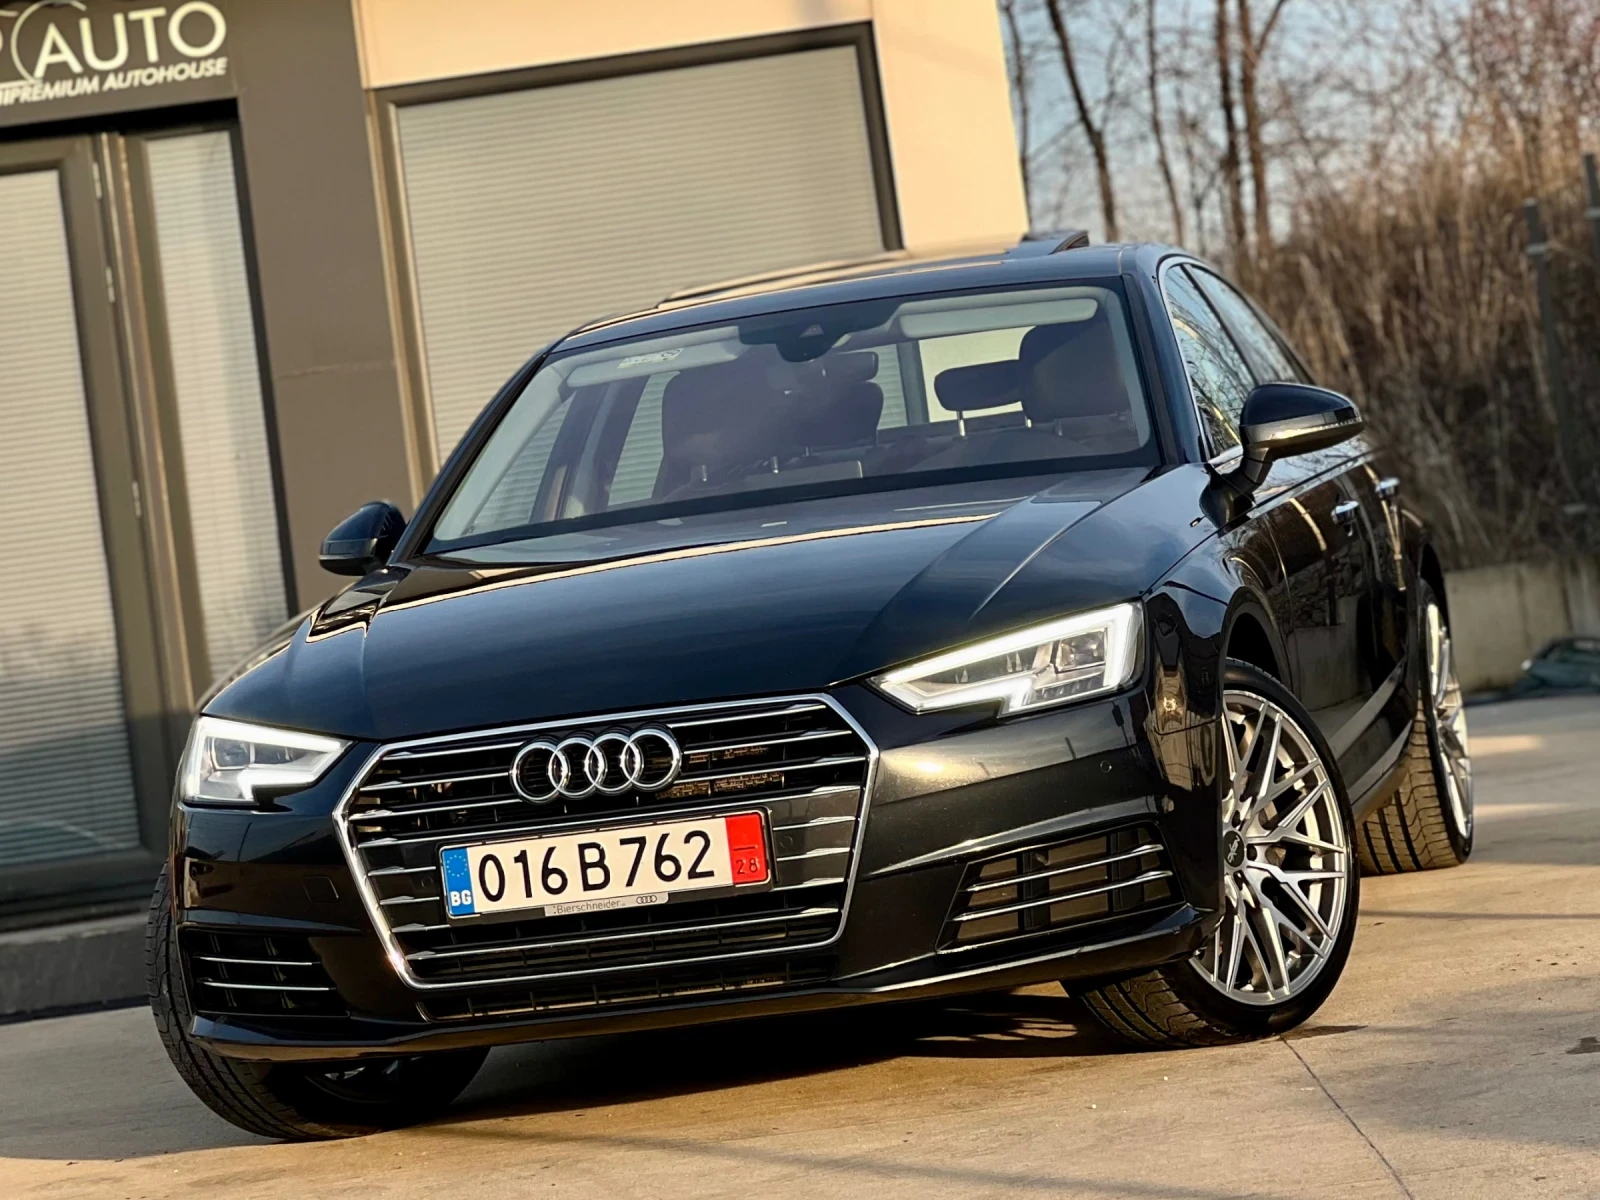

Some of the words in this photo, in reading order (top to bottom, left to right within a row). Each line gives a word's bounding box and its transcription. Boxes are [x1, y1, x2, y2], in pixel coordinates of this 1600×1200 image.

[33, 1, 227, 79] AUTO
[102, 57, 228, 91] AUTOHOUSE
[735, 857, 759, 875] 28
[450, 889, 473, 907] BG
